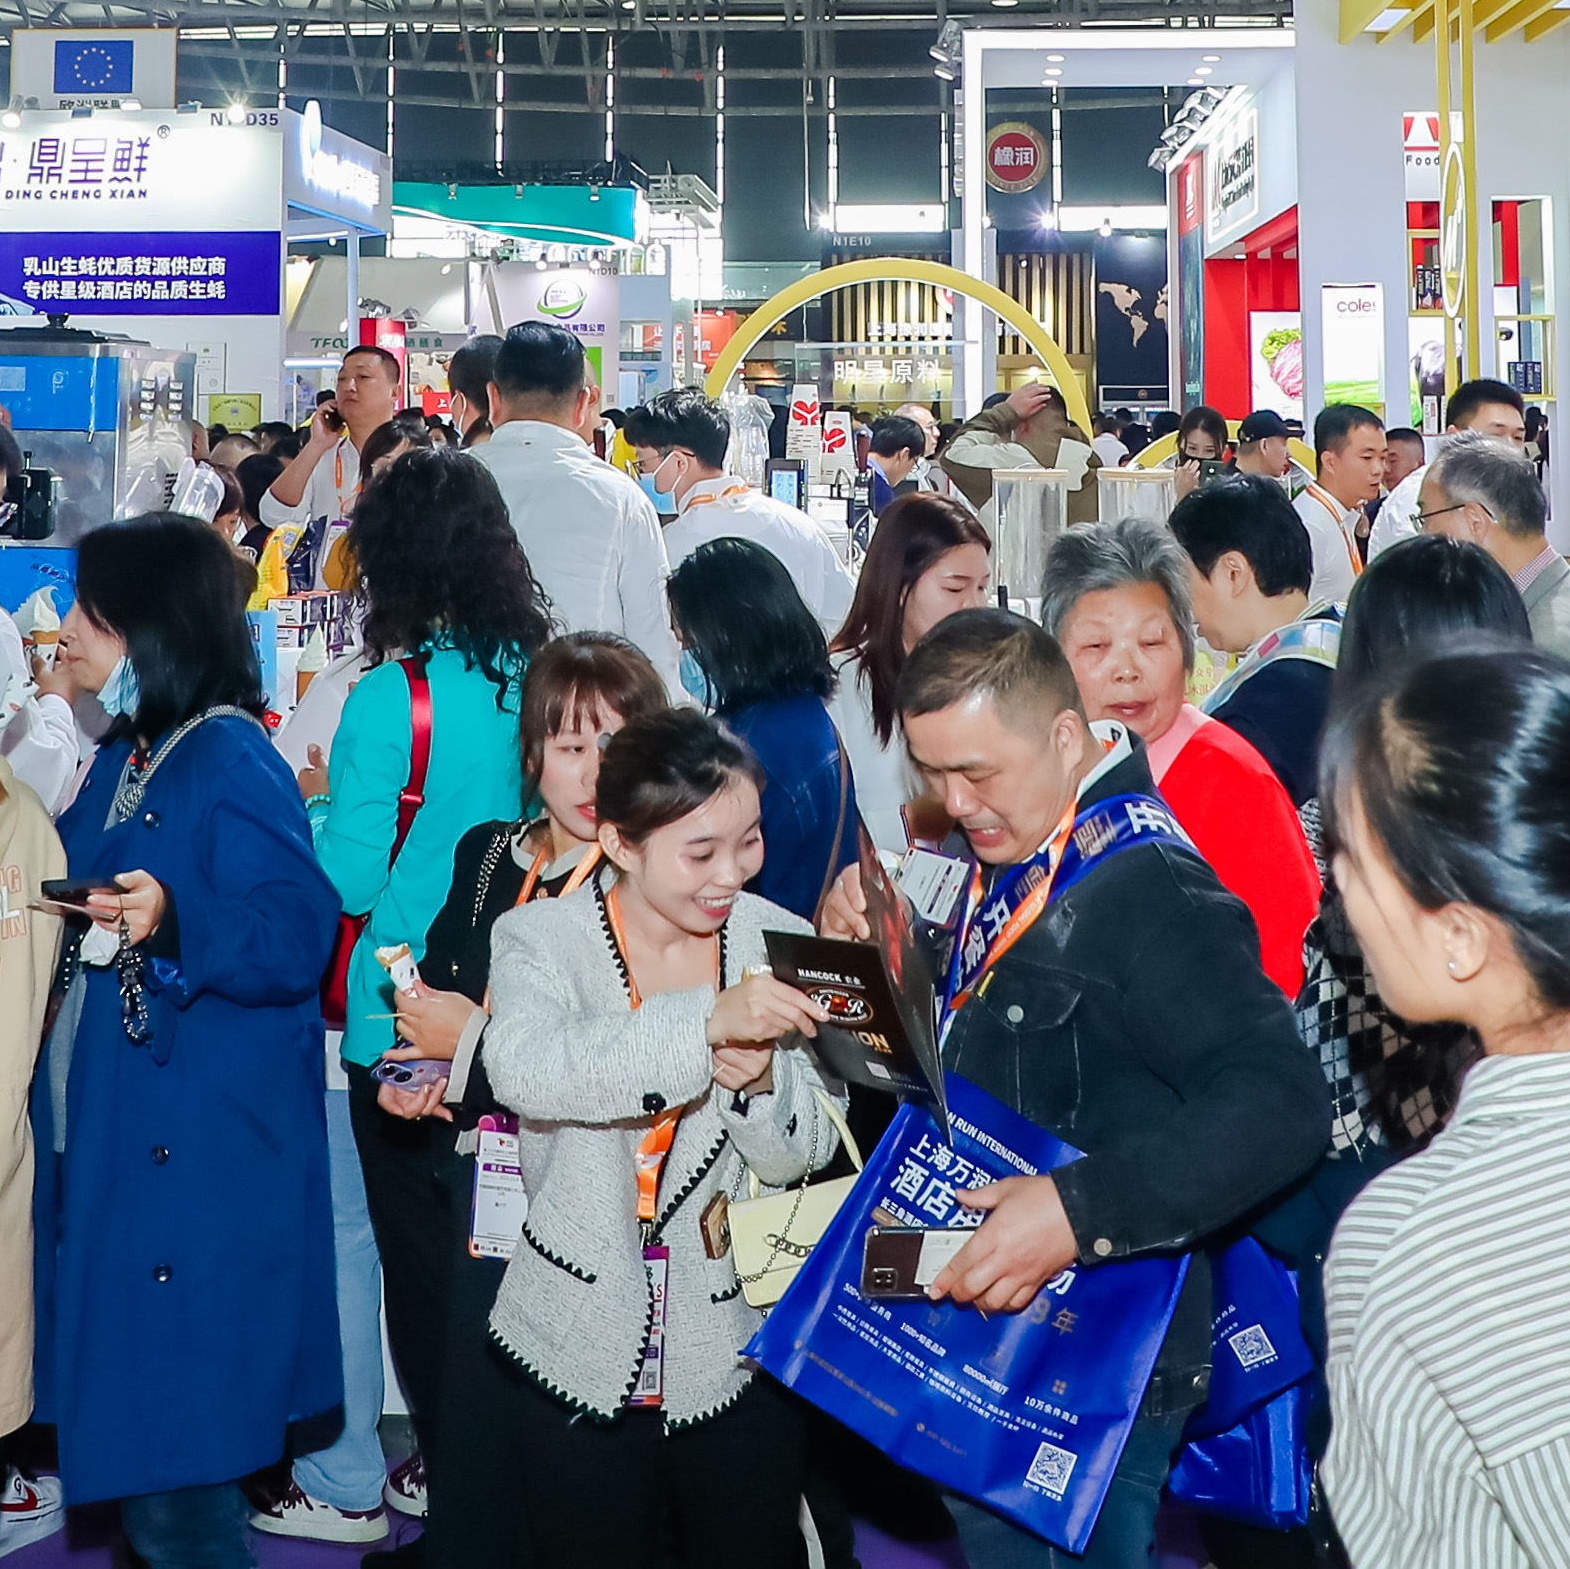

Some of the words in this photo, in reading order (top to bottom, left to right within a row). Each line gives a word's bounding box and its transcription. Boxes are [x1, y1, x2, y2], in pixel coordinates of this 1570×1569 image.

[5, 189, 42, 201] DING
[49, 189, 102, 201] CHENG
[109, 189, 148, 201] XIAN
[832, 236, 872, 247] N1E10
[23, 256, 226, 277] 乳山生蚝优质货源供应商
[23, 280, 226, 300] 专供星级酒店的品质生蚝
[833, 359, 942, 385] 明星原料
[797, 968, 842, 982] HANCOCK
[954, 1117, 978, 1137] RUN
[909, 1133, 997, 1190] 上海万润
